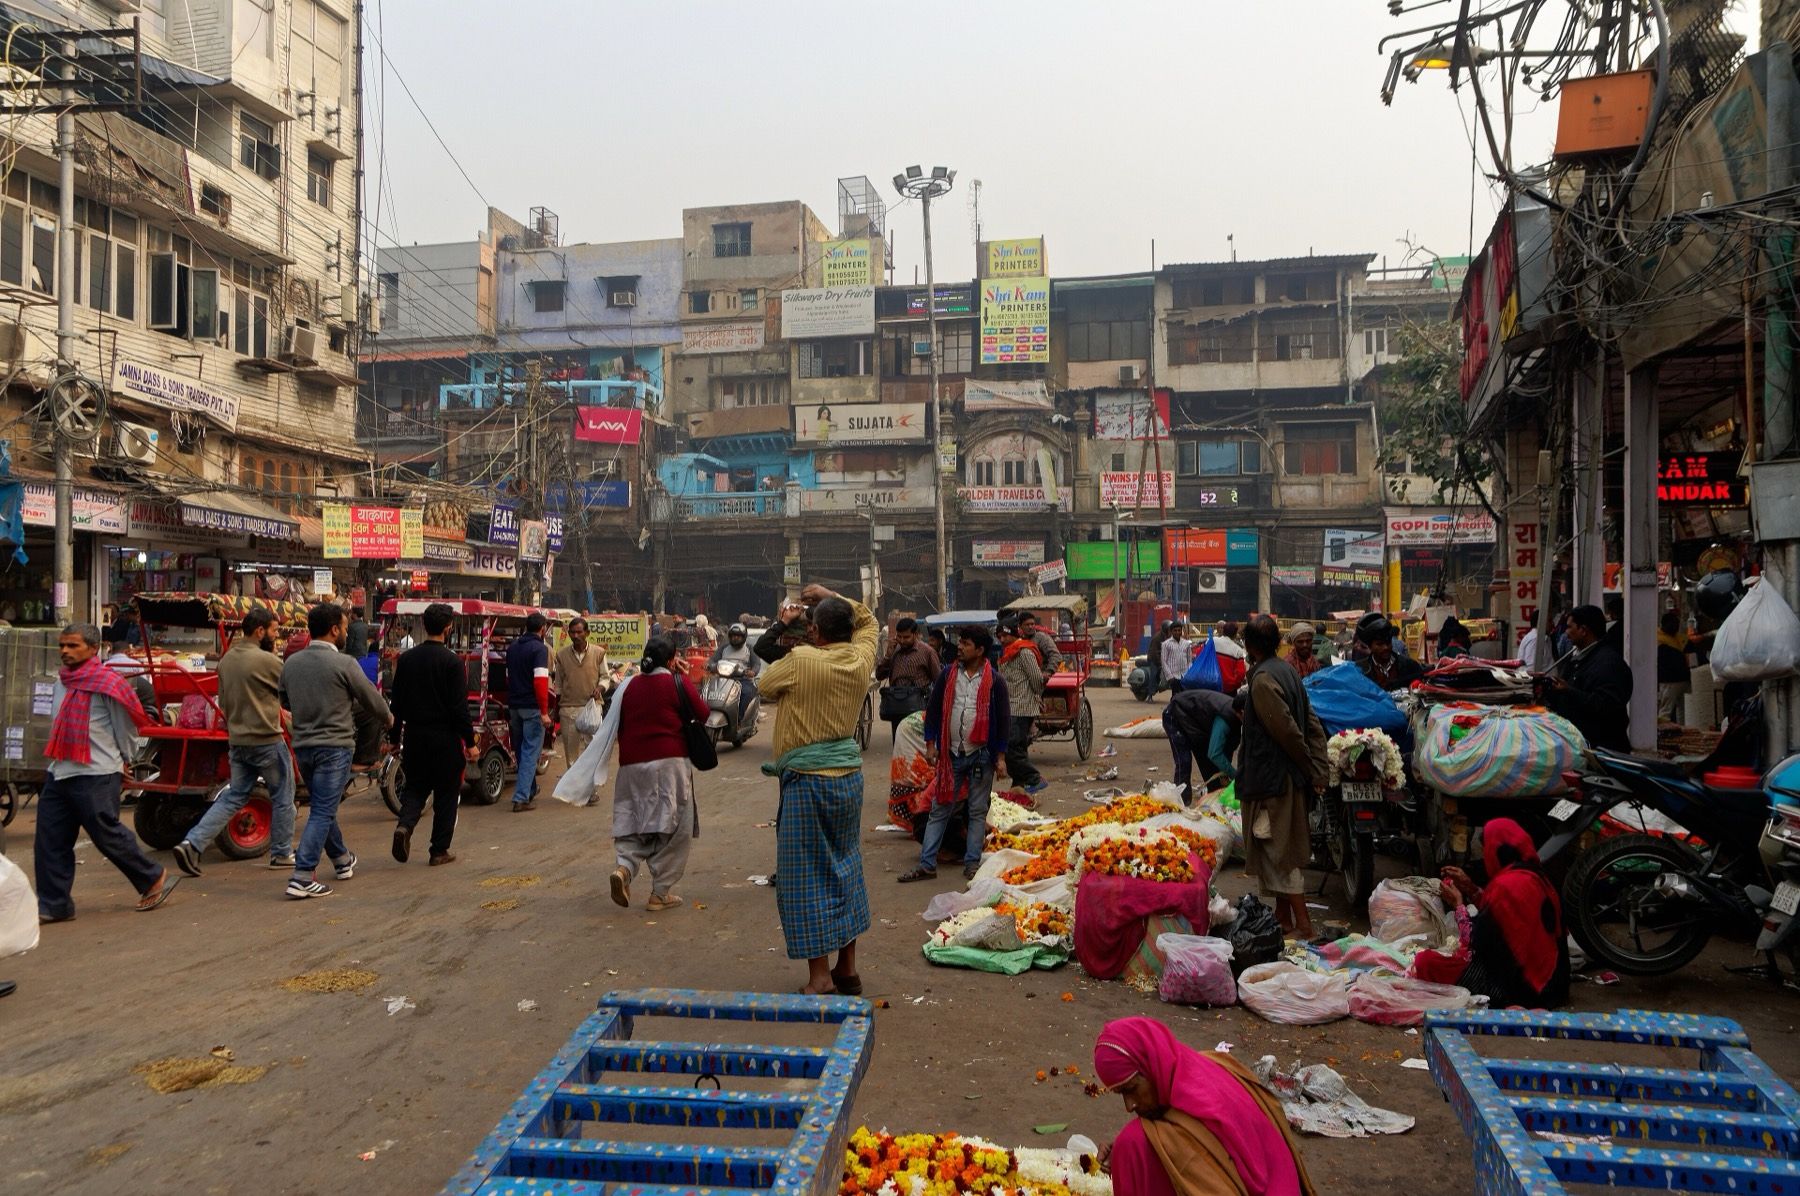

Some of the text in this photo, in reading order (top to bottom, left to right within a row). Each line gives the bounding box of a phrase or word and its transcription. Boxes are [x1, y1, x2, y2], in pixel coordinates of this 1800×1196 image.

[828, 261, 867, 270] PRINTERS
[994, 259, 1038, 271] PRINTERS
[783, 288, 873, 303] Silkways Dry Fruits
[1000, 303, 1047, 312] PRINTERS
[119, 362, 141, 381] JAMNA
[143, 370, 160, 388] DASS
[162, 377, 167, 390] &
[168, 379, 185, 396] SONS
[186, 385, 209, 407] TRADERS
[210, 396, 224, 413] PVT.
[589, 420, 627, 431] LAVA
[849, 416, 893, 430] SUJATA
[1103, 473, 1171, 483] TWINS PTUES
[997, 489, 1034, 500] TRAVELS
[1657, 481, 1731, 501] ANDAR
[84, 491, 120, 506] Chand
[1201, 493, 1217, 504] 52
[72, 515, 91, 525] ANG
[99, 518, 120, 528] Paras
[183, 507, 291, 538] JAMNA DASS & SONS TRADERS PVT. LTD.
[1391, 520, 1493, 531] GOPI DRY FRUITS
[352, 522, 369, 535] हवन
[373, 522, 399, 535] जागरण
[1323, 571, 1335, 579] NEW
[589, 620, 639, 634] च्छरछाप
